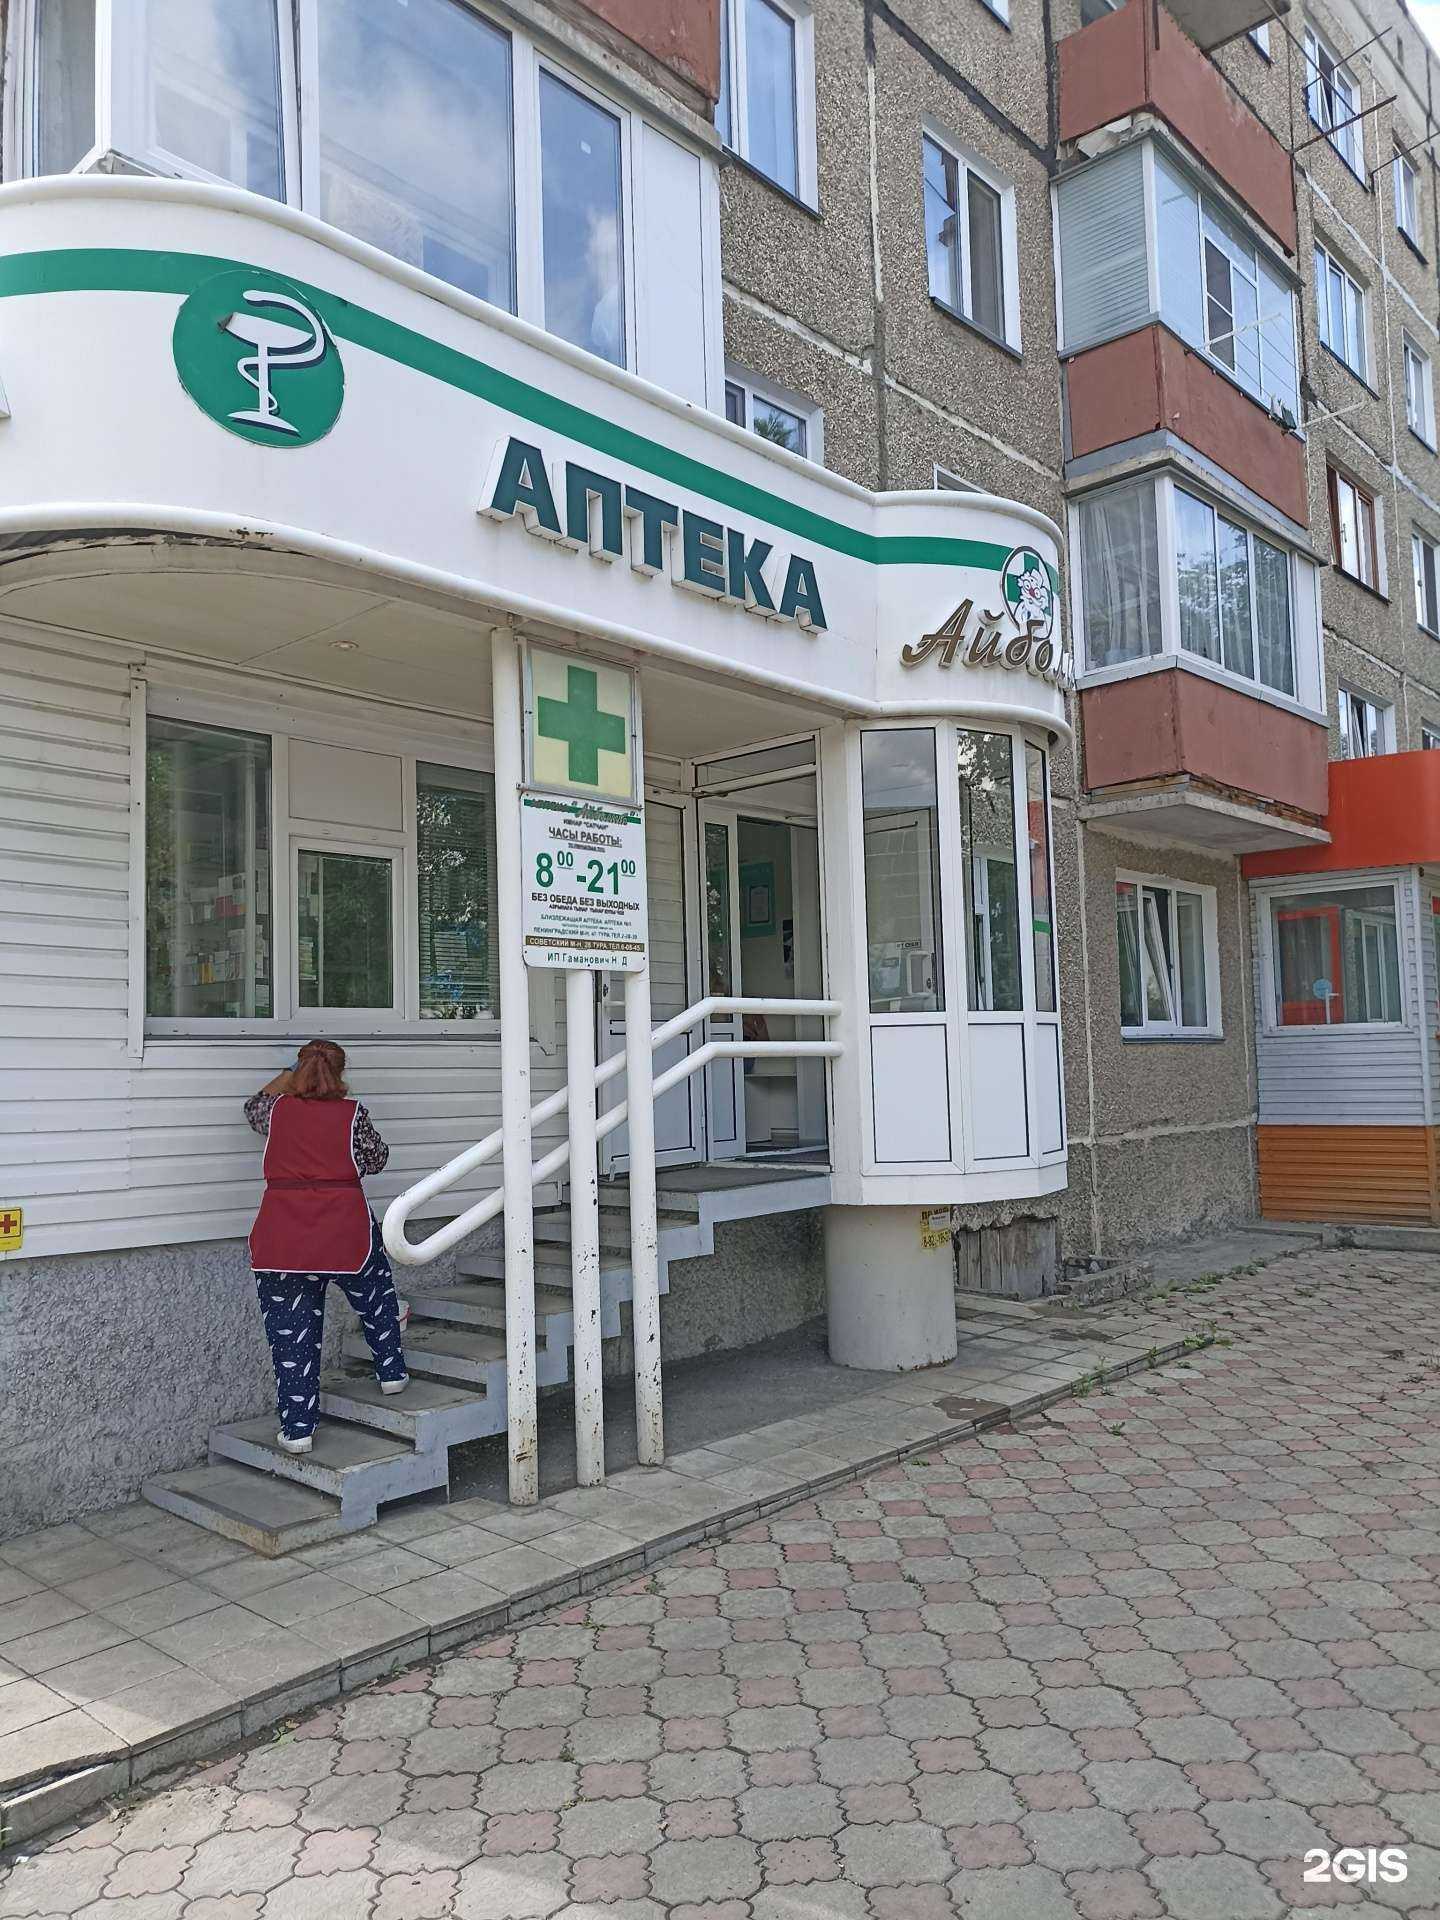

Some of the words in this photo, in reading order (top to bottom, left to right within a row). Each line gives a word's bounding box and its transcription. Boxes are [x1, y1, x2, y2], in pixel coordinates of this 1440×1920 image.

[479, 436, 829, 634] АПТЕКА
[900, 598, 1073, 692] Айбо
[548, 826, 579, 840] ЧАСЫ
[531, 892, 548, 902] БЕЗ
[550, 894, 578, 905] ОБЕДА
[580, 897, 594, 907] БЕЗ
[596, 898, 640, 911] ВЫХОДНЫХ
[529, 938, 570, 947] СОВЕТСКИЙ
[547, 953, 560, 962] ИП
[562, 953, 609, 965] Гаманович
